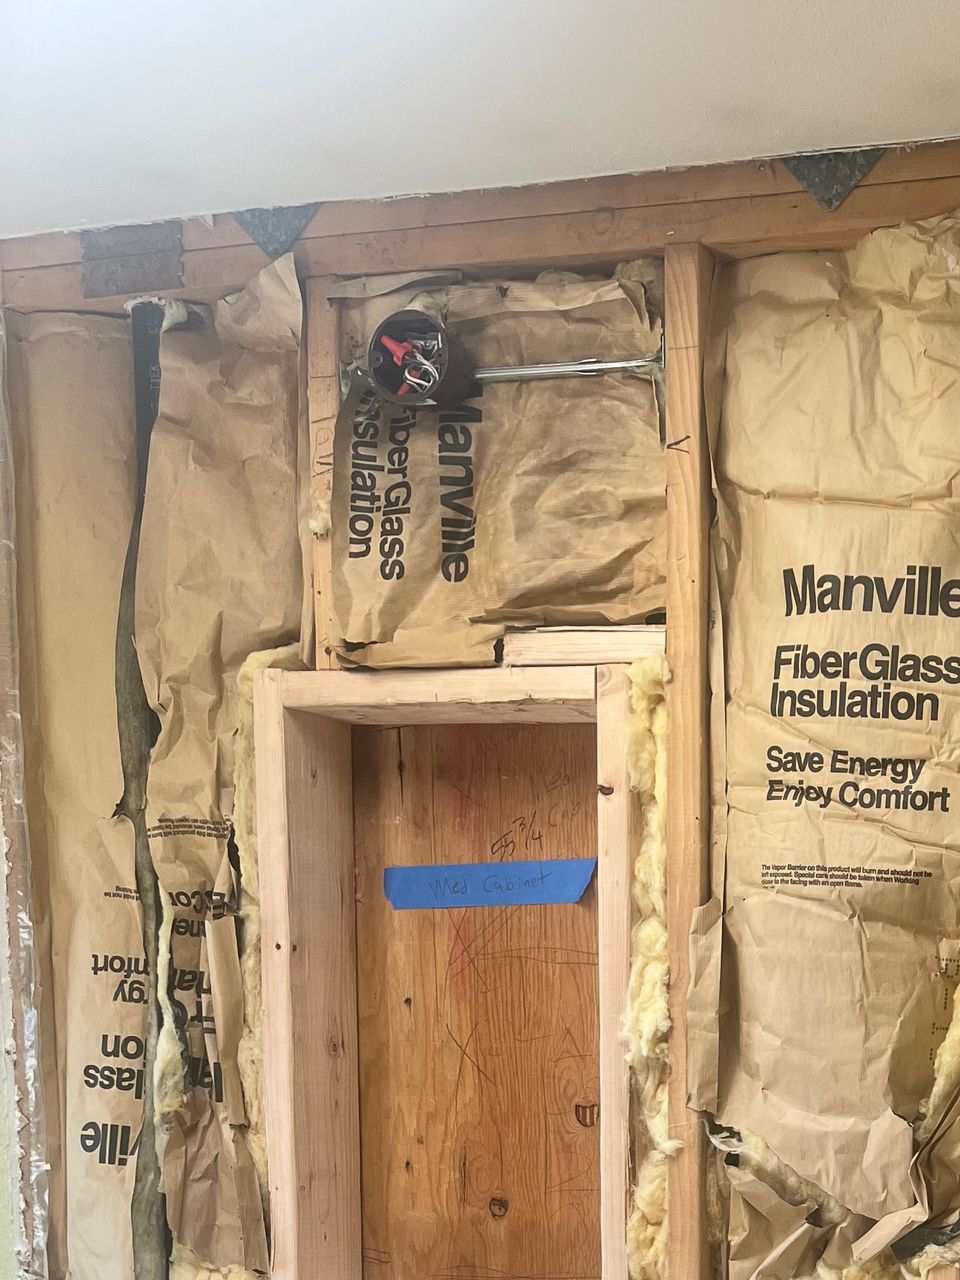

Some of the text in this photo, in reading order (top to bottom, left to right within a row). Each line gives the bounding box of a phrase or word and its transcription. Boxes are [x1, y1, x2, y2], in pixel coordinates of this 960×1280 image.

[770, 682, 938, 720] Insulation
[766, 746, 926, 783] Save Energy
[766, 780, 950, 812] Enjoy Comfort
[483, 869, 552, 894] Cabinet
[81, 1121, 141, 1166] ille
